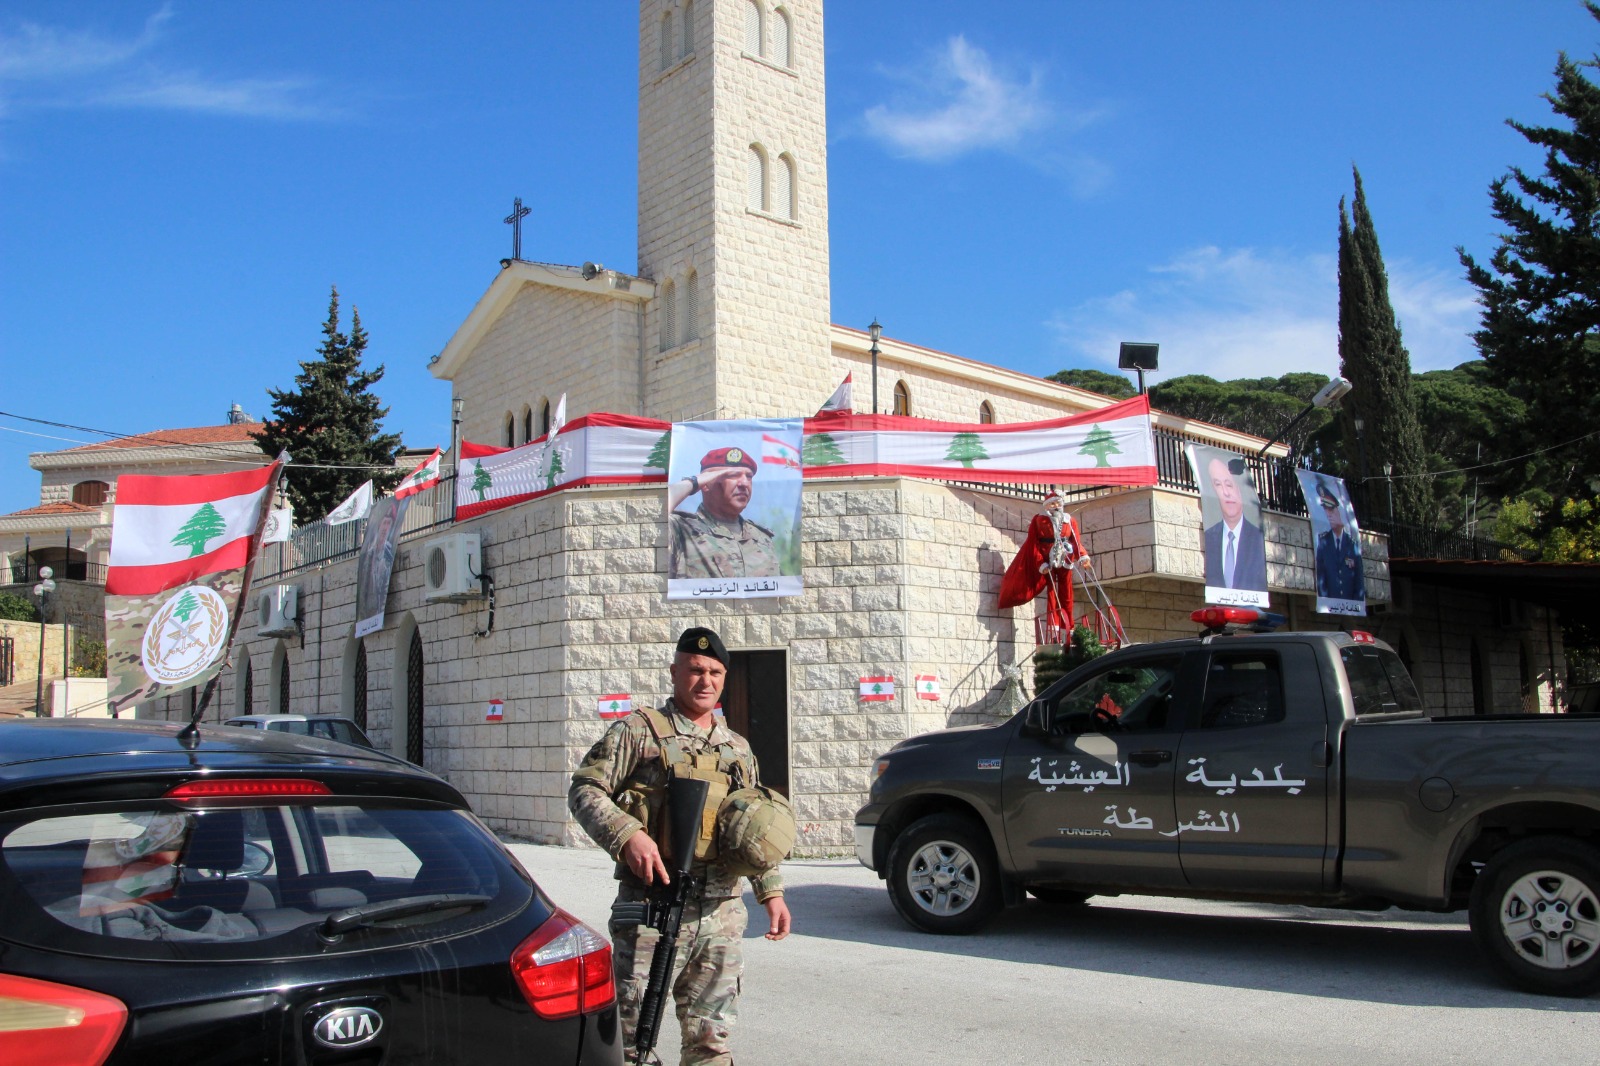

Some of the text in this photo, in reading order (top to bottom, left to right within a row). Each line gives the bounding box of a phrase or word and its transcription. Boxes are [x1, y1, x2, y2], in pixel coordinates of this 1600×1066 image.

[743, 580, 779, 592] القائد
[1185, 757, 1306, 795] بلدية
[1057, 827, 1112, 837] TUNDRA
[326, 1013, 374, 1041] KIA
